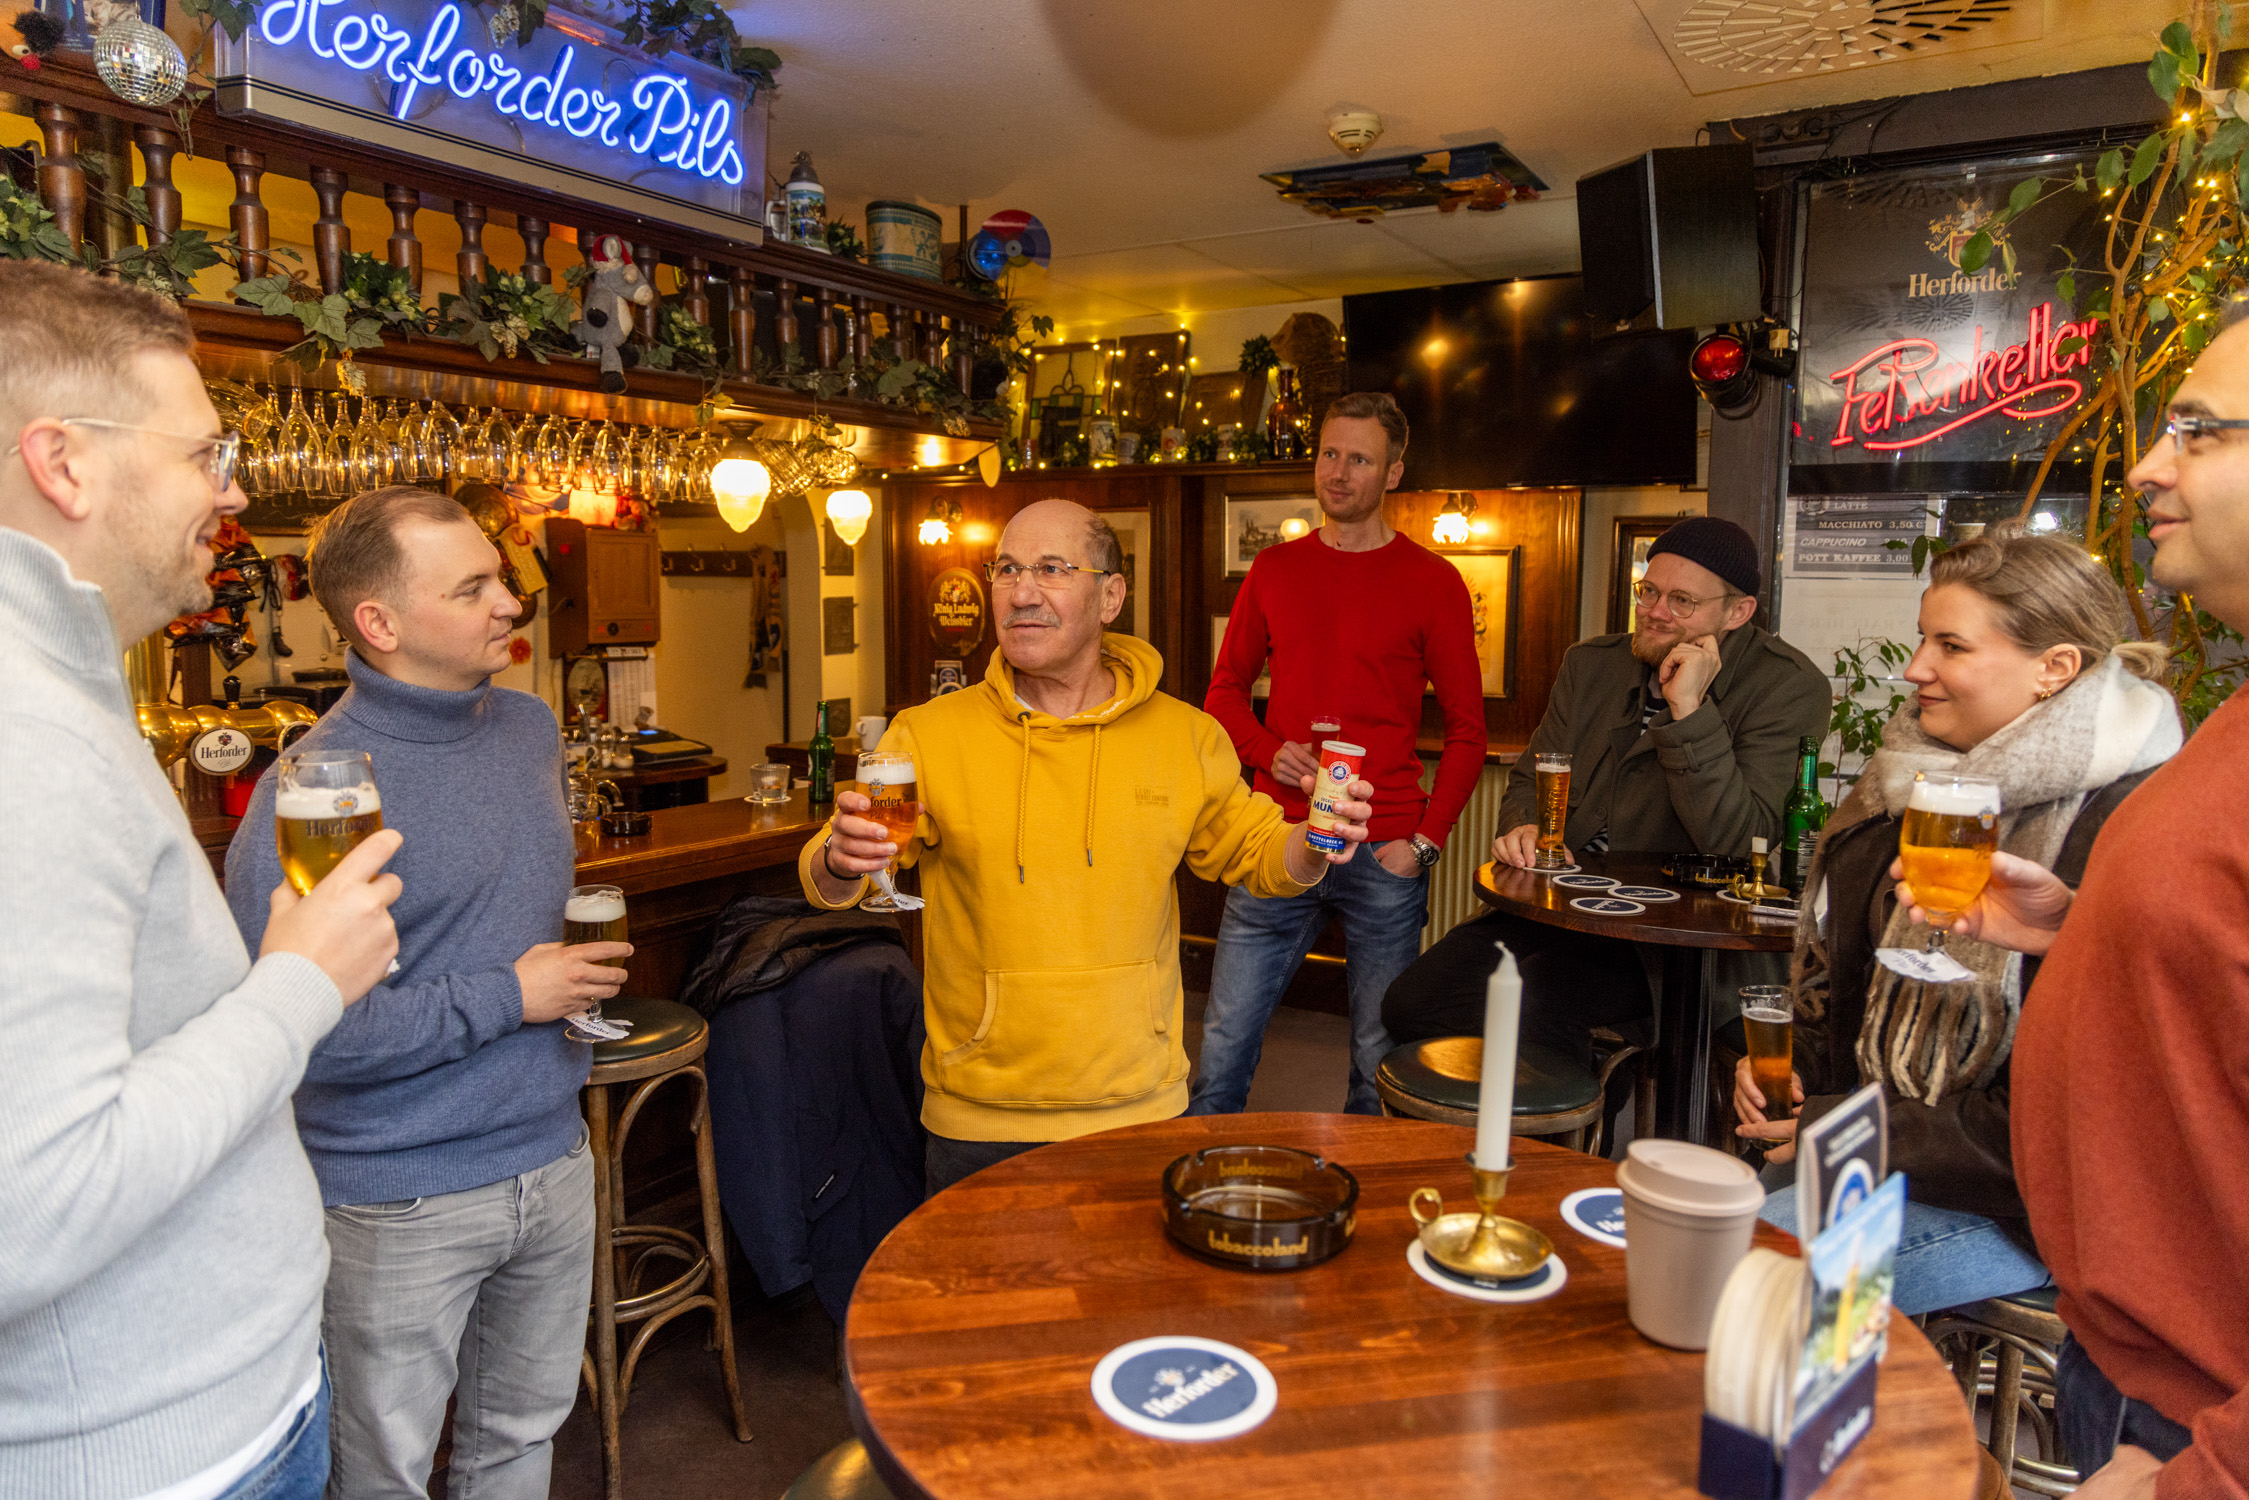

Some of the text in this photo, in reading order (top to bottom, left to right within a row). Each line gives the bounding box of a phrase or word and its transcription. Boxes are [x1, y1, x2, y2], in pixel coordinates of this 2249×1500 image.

[260, 0, 745, 186] Herforder Pils
[1818, 521, 1883, 529] MACCHIATO
[1889, 521, 1913, 530] 3,50
[1800, 538, 1867, 547] CAPPUCINO
[1798, 553, 1829, 562] POTT
[1833, 554, 1881, 562] KAFFEE
[953, 603, 979, 617] Ludwig
[201, 745, 248, 759] Herforder
[870, 795, 902, 808] forder
[1695, 872, 1739, 884] tobaccola
[1896, 949, 1935, 974] erforder
[1207, 1229, 1309, 1257] tobaccoland
[1141, 1361, 1240, 1419] Herforder
